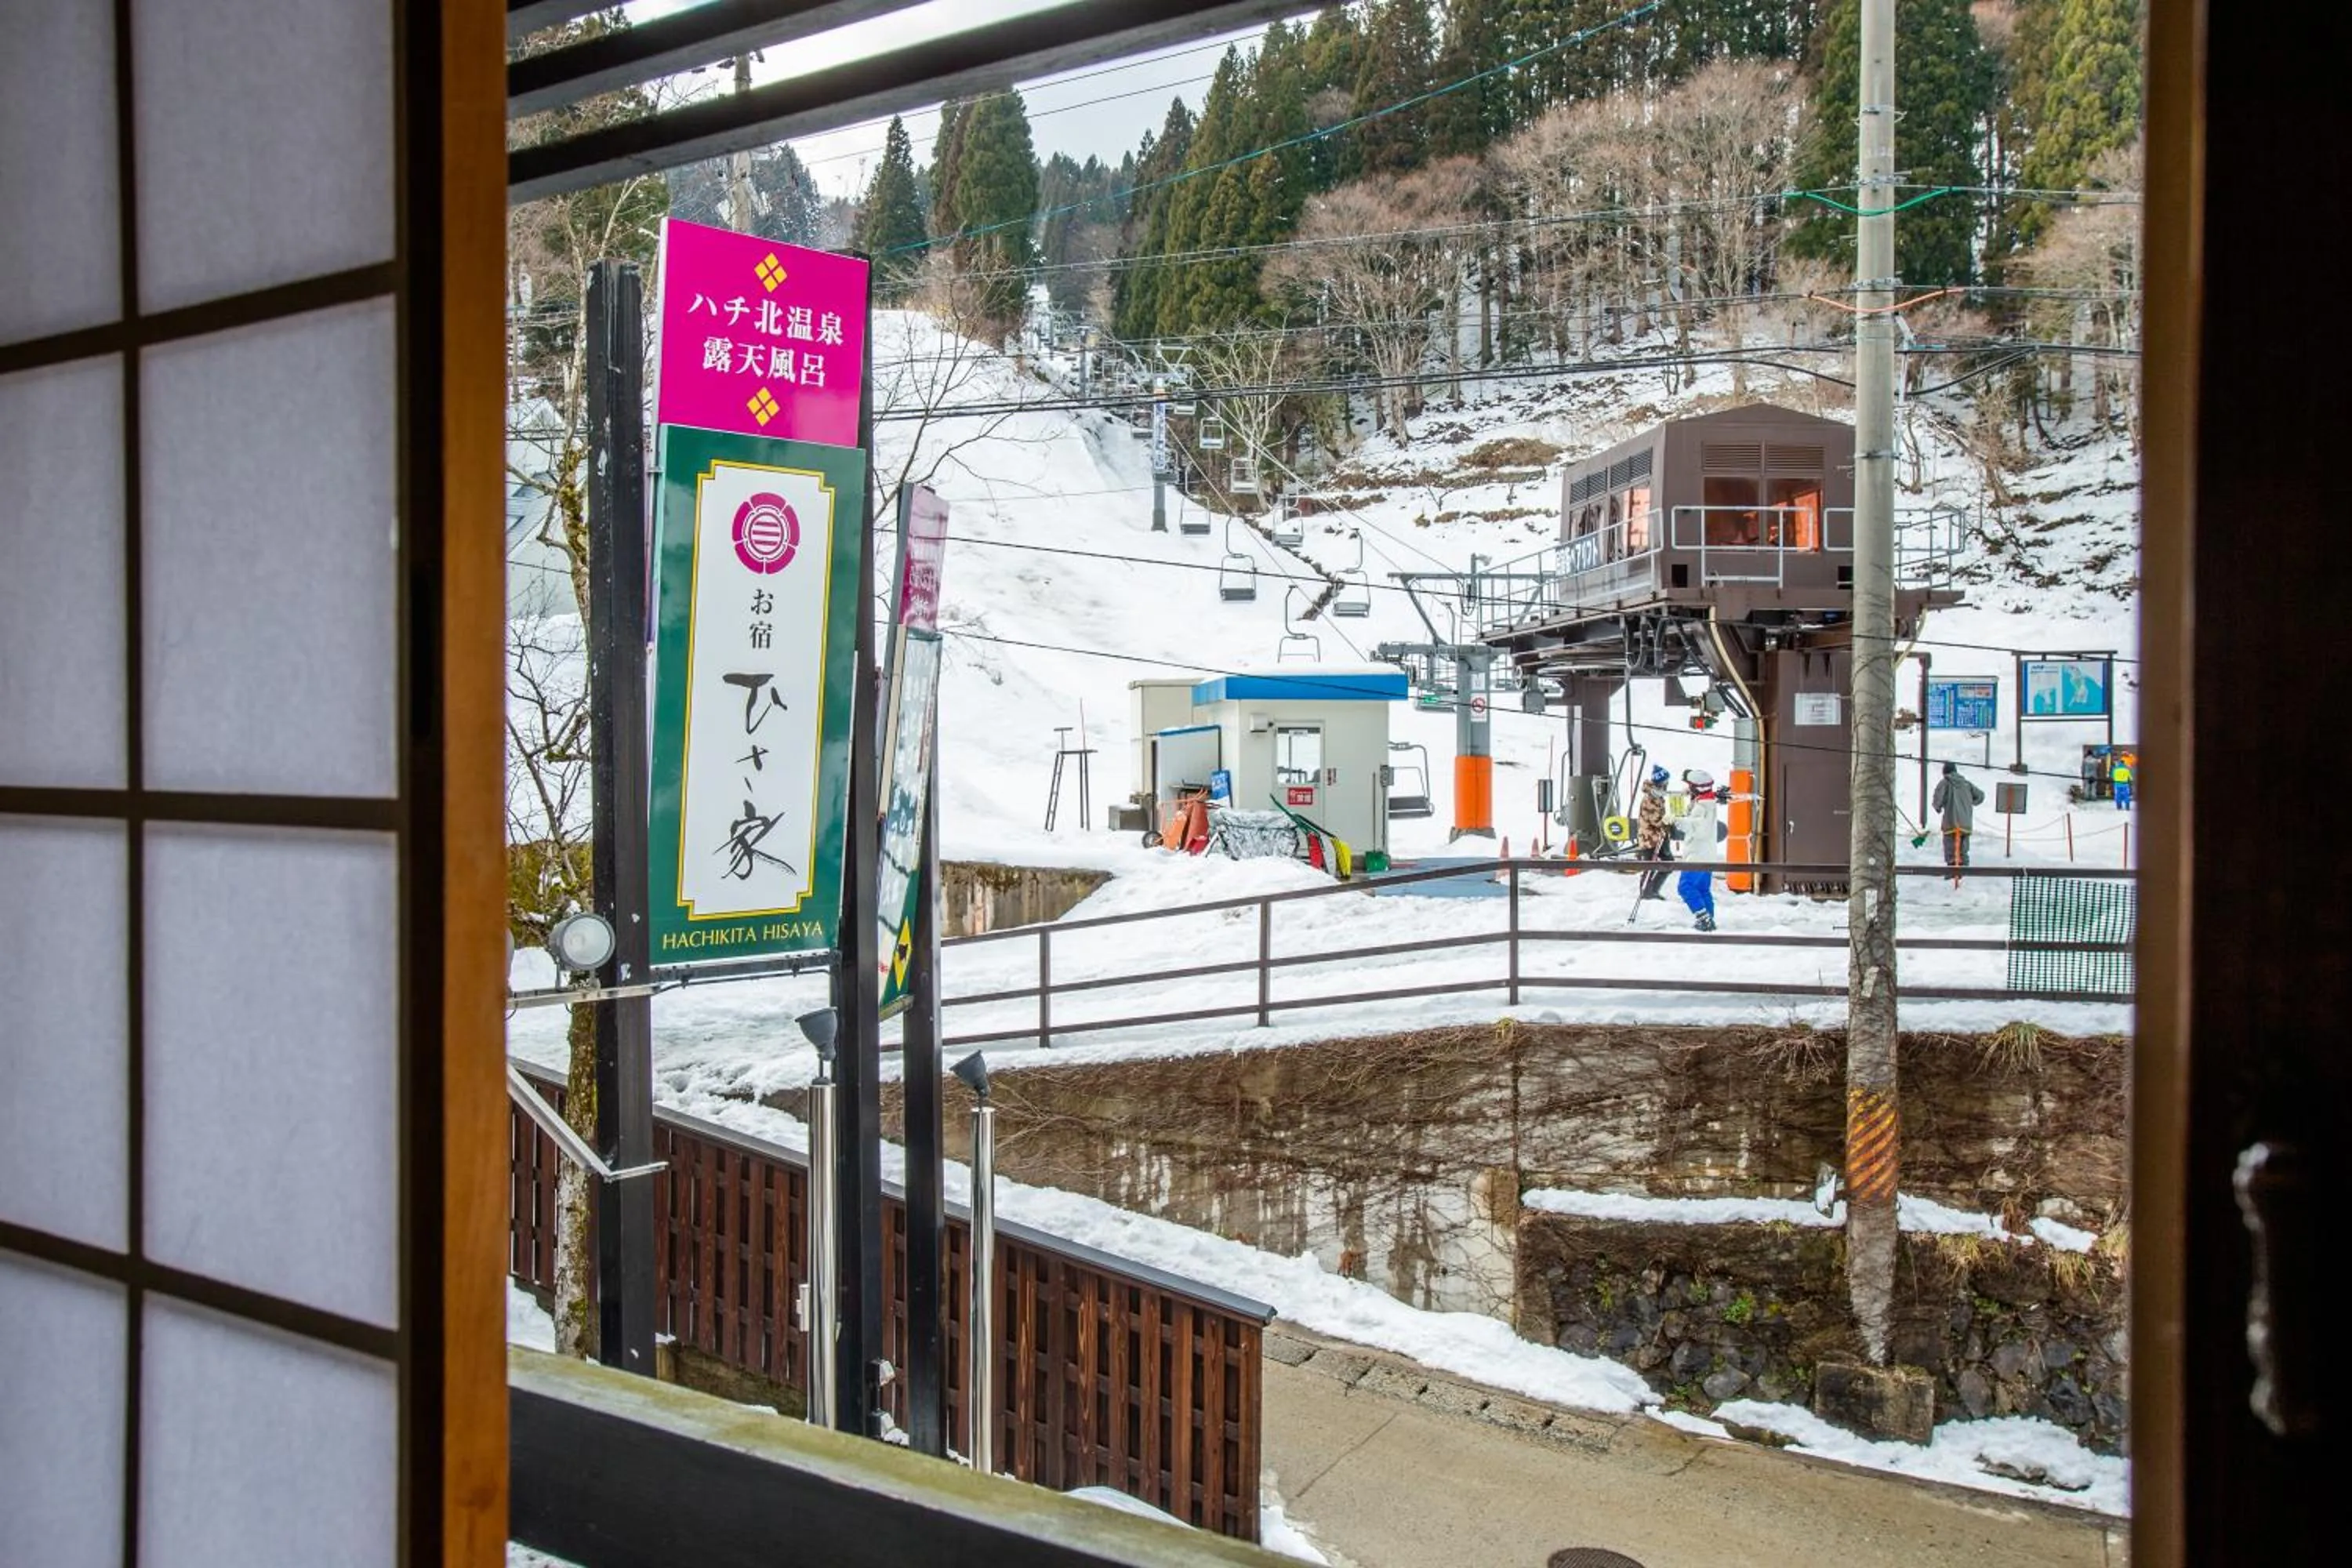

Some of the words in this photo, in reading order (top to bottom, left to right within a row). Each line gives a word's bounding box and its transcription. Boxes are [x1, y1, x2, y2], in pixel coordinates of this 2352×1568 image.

[688, 293, 844, 346] ハチ北温泉
[702, 336, 826, 387] 露天風呂
[750, 590, 774, 649] お宿
[662, 926, 757, 950] HACHIKITA
[764, 921, 824, 939] HISAYA
